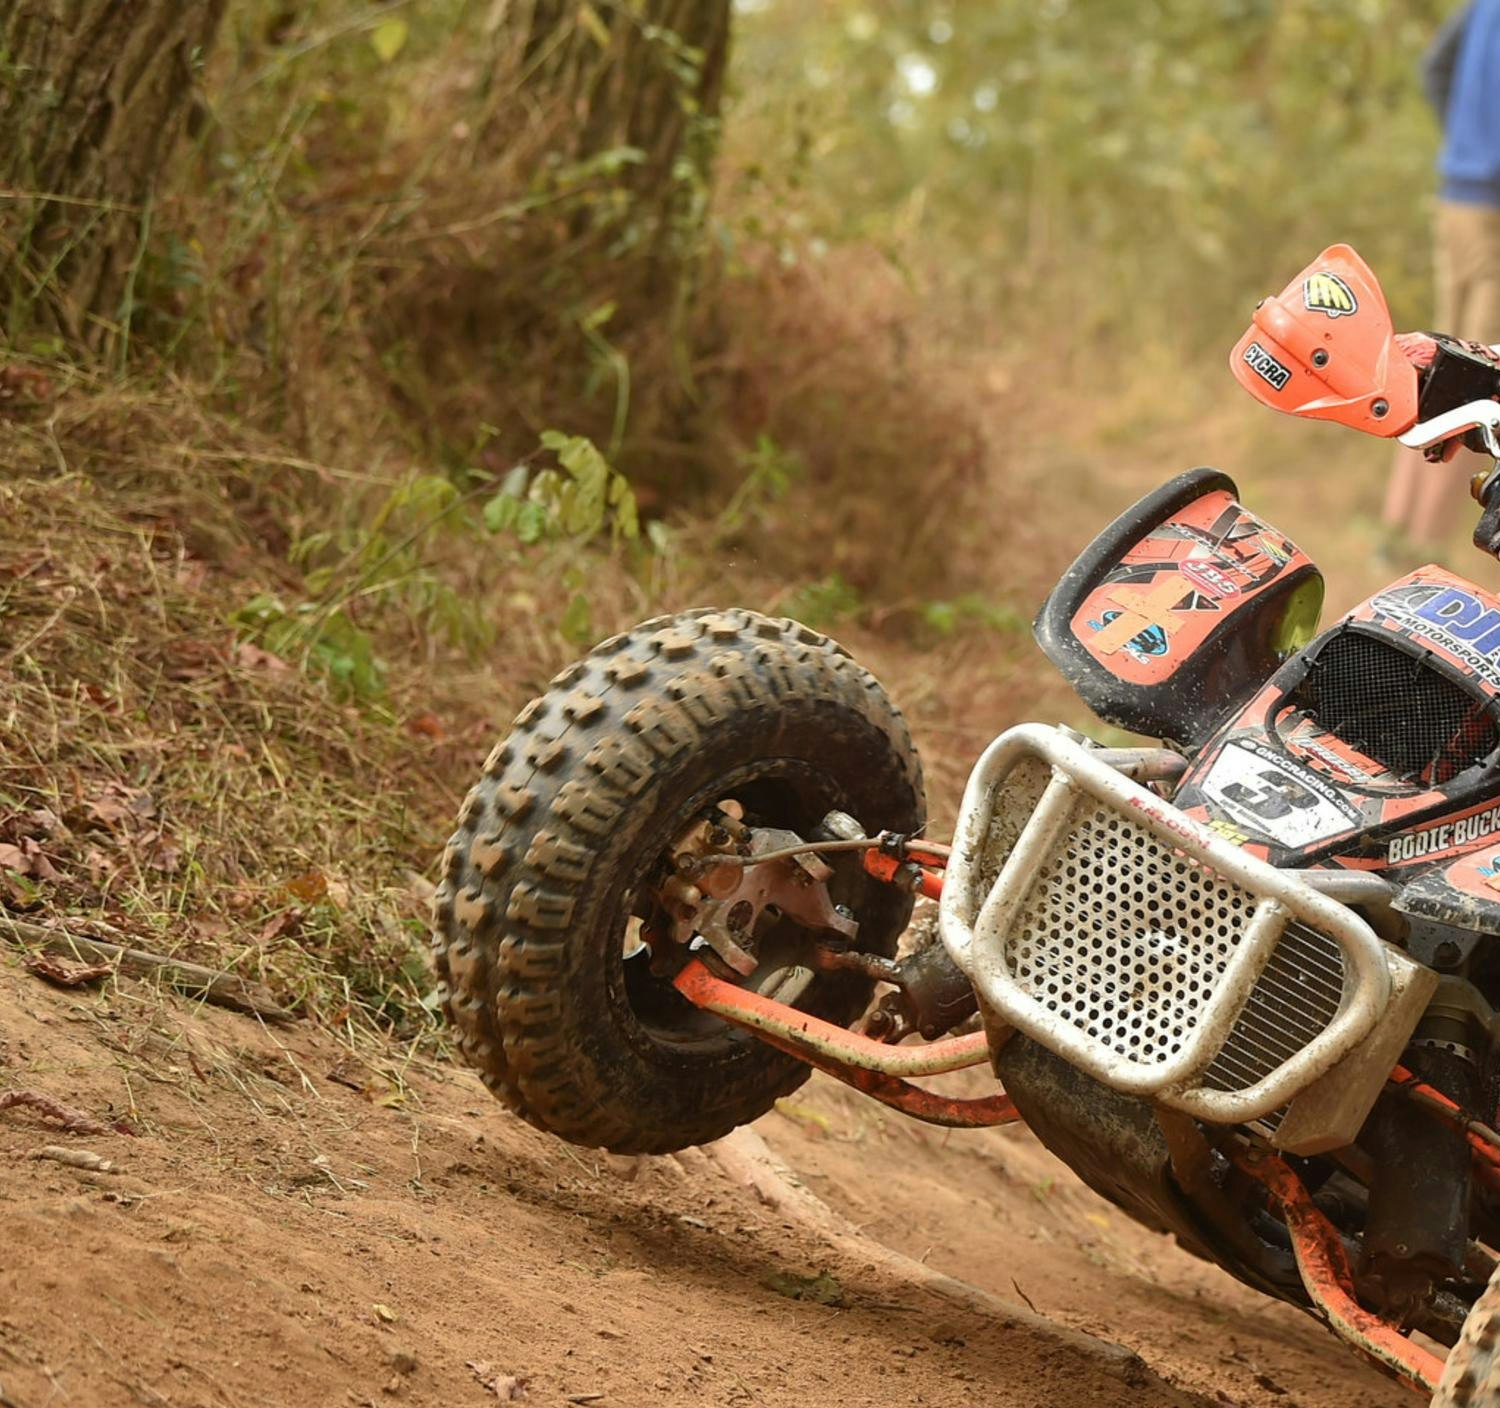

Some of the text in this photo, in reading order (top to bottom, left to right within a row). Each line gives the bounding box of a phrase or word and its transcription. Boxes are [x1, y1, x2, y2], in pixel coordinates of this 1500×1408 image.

[1244, 344, 1289, 388] CYCRA
[1187, 560, 1237, 595] JBS
[1221, 769, 1320, 820] 3
[1255, 746, 1358, 819] GNCCRACING.COM
[1388, 824, 1452, 865] BODIE
